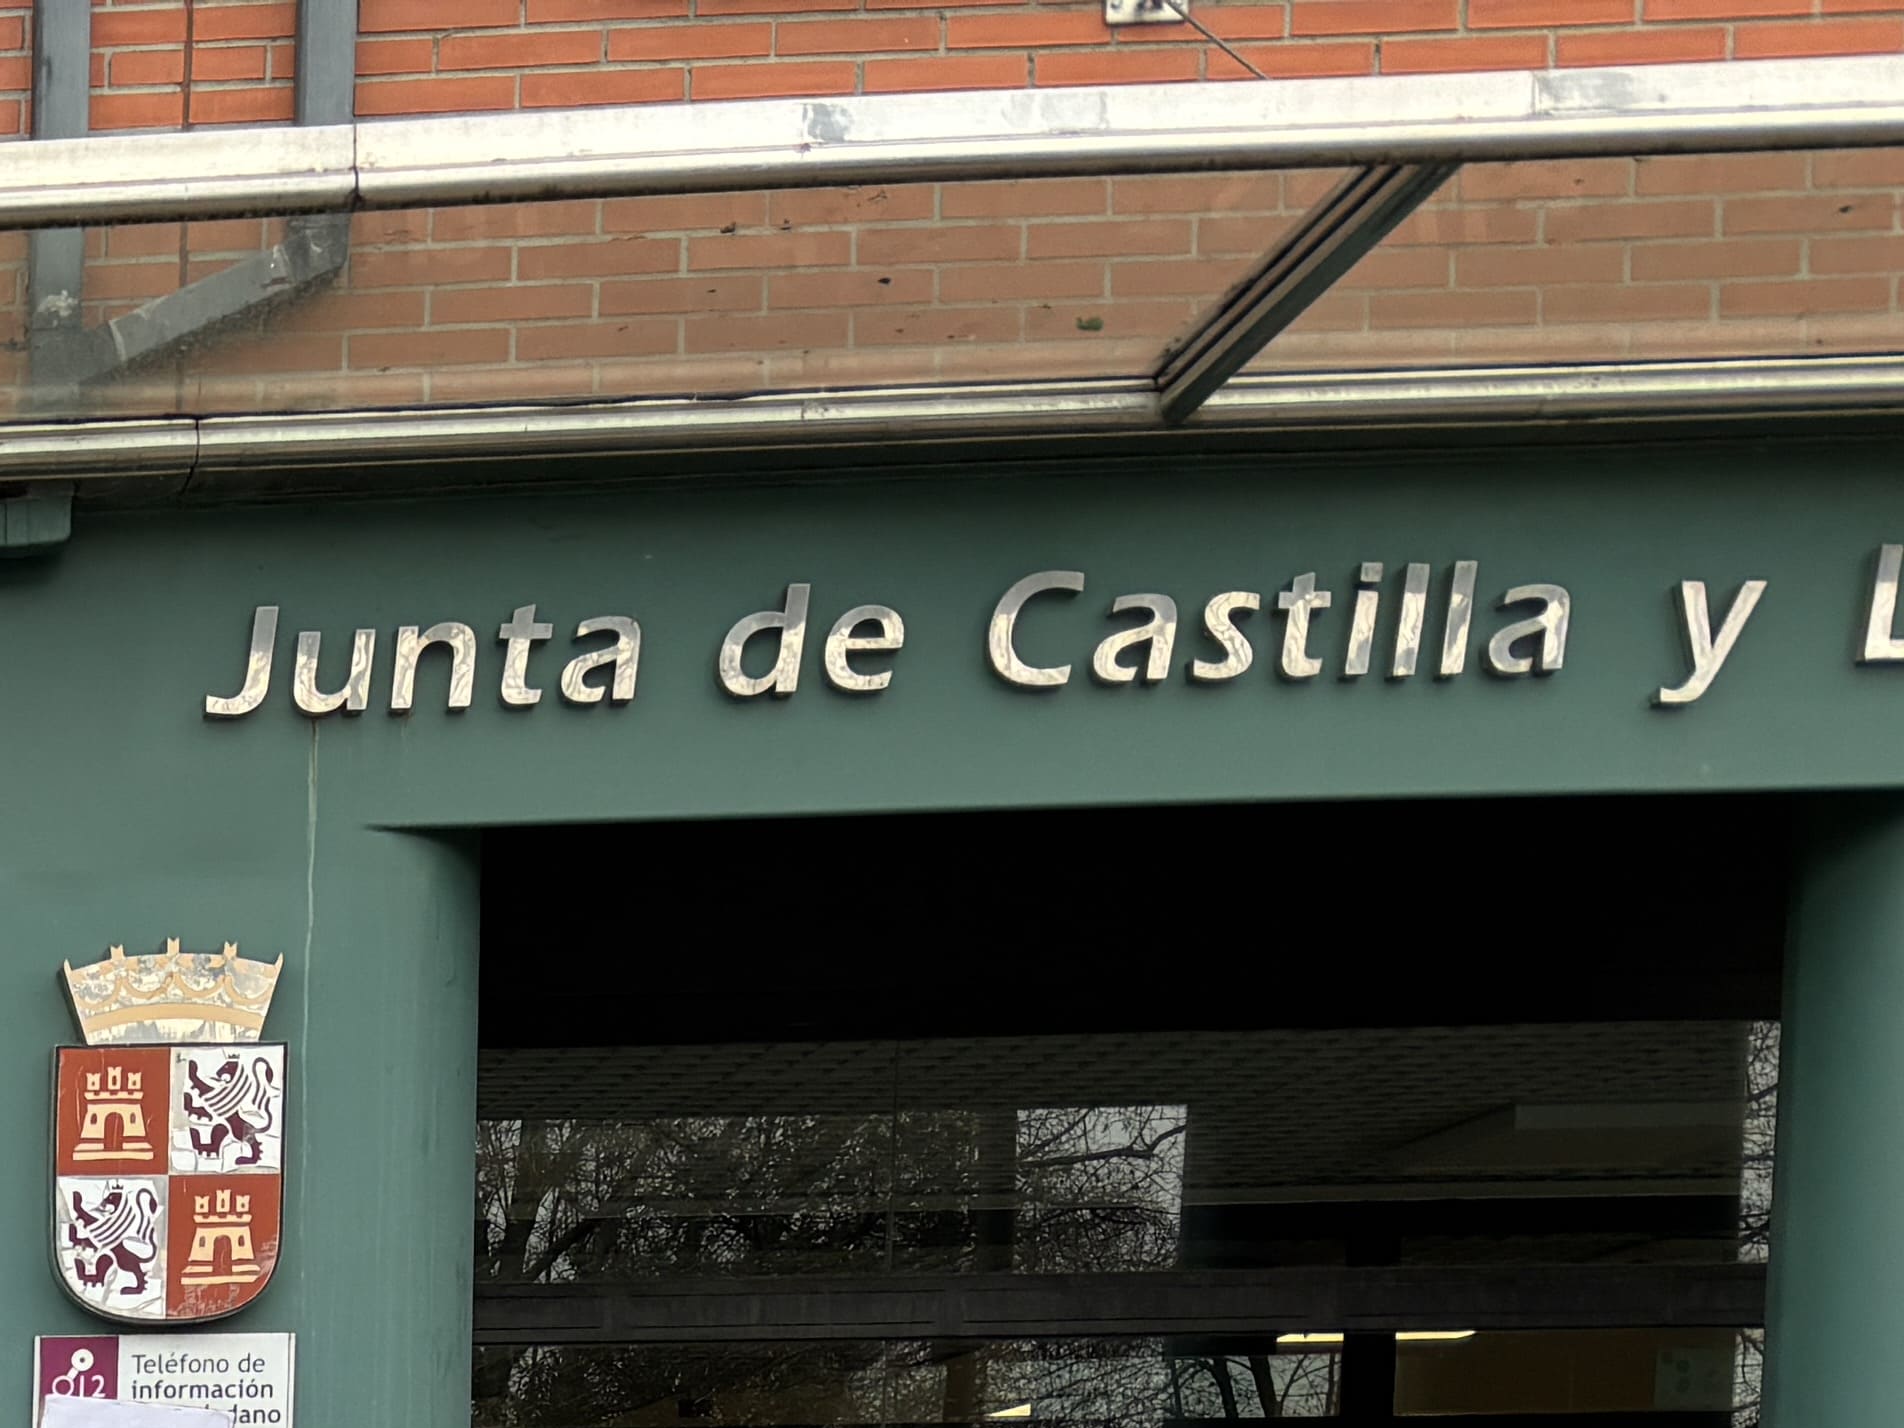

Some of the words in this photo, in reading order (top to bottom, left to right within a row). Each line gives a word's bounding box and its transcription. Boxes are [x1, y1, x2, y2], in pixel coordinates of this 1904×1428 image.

[201, 602, 645, 722] Junta
[716, 581, 906, 701] de
[987, 557, 1572, 690] Castilla
[1650, 576, 1769, 709] y
[131, 1352, 230, 1374] Teléfono
[238, 1352, 266, 1374] de
[131, 1378, 274, 1400] información
